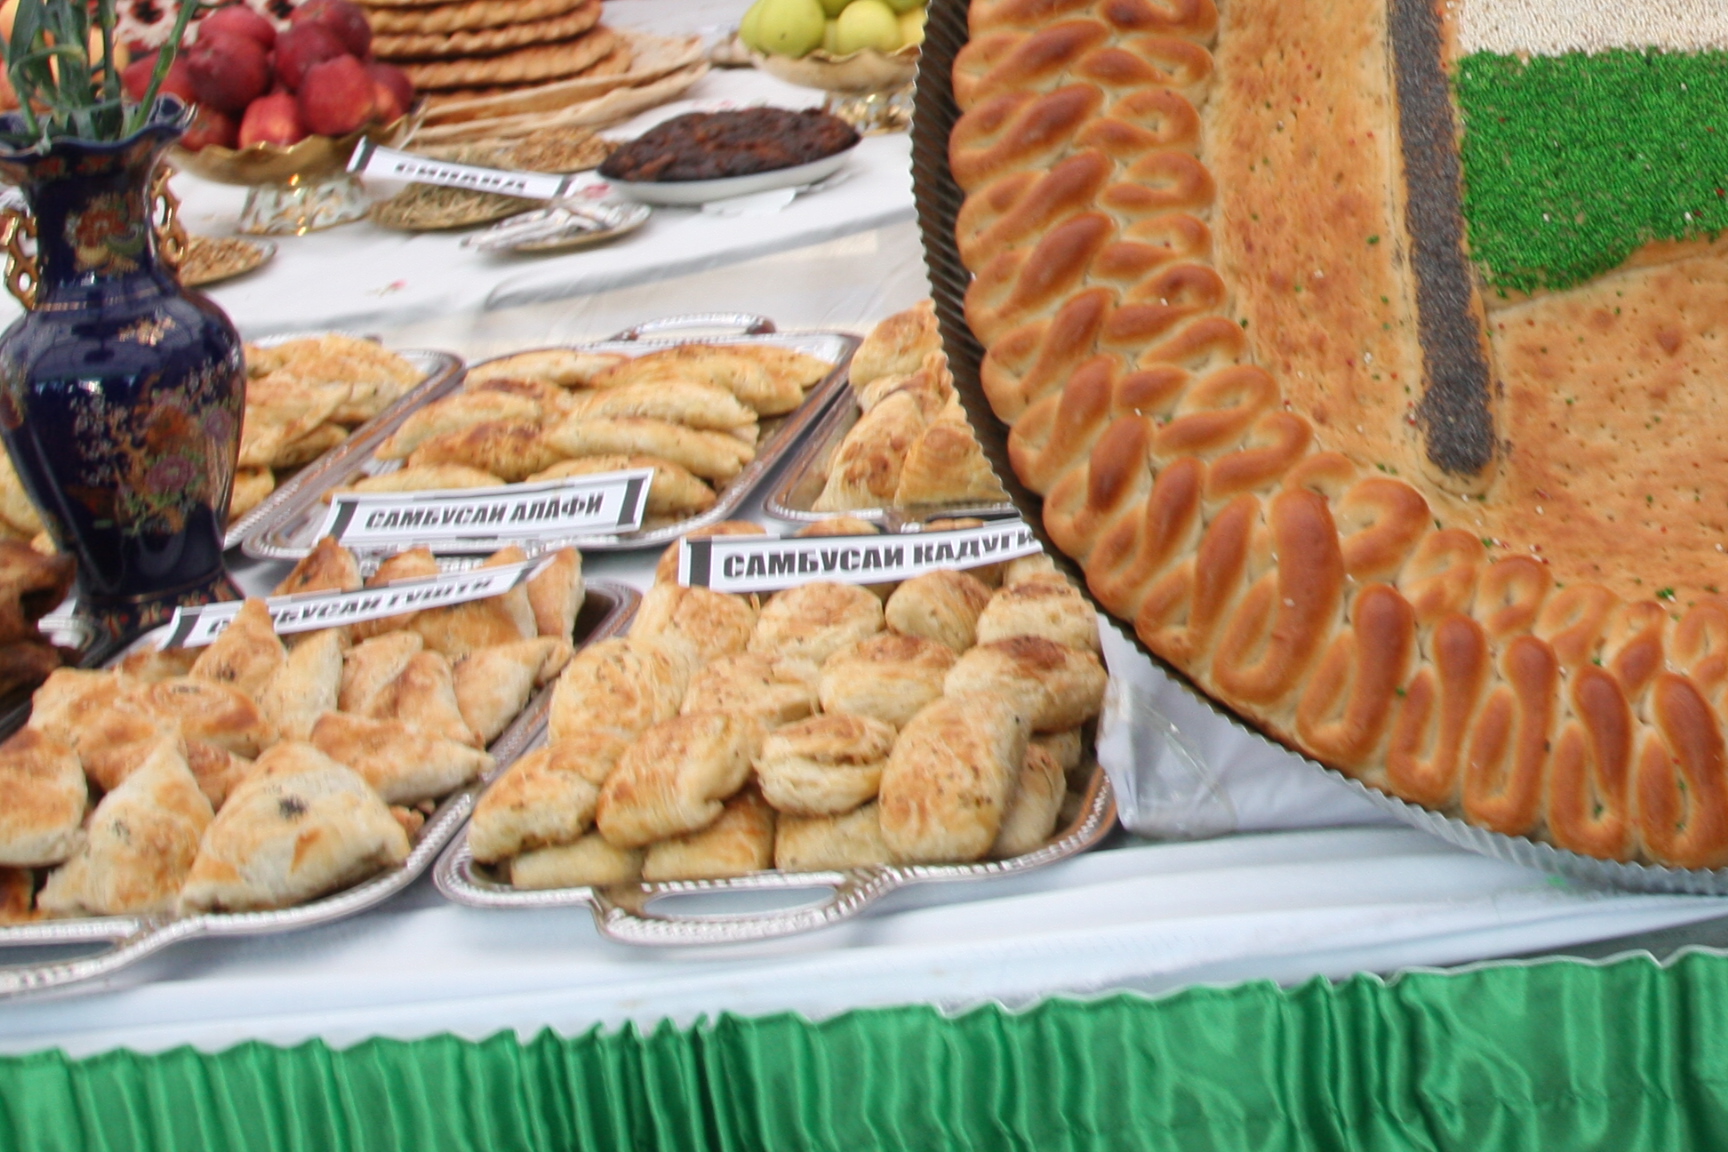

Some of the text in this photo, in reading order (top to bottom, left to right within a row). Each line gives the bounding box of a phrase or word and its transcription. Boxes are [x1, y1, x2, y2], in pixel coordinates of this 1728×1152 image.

[365, 492, 604, 528] САМБУСАИ АЛАФИ
[723, 547, 906, 578] САМБУСАИ
